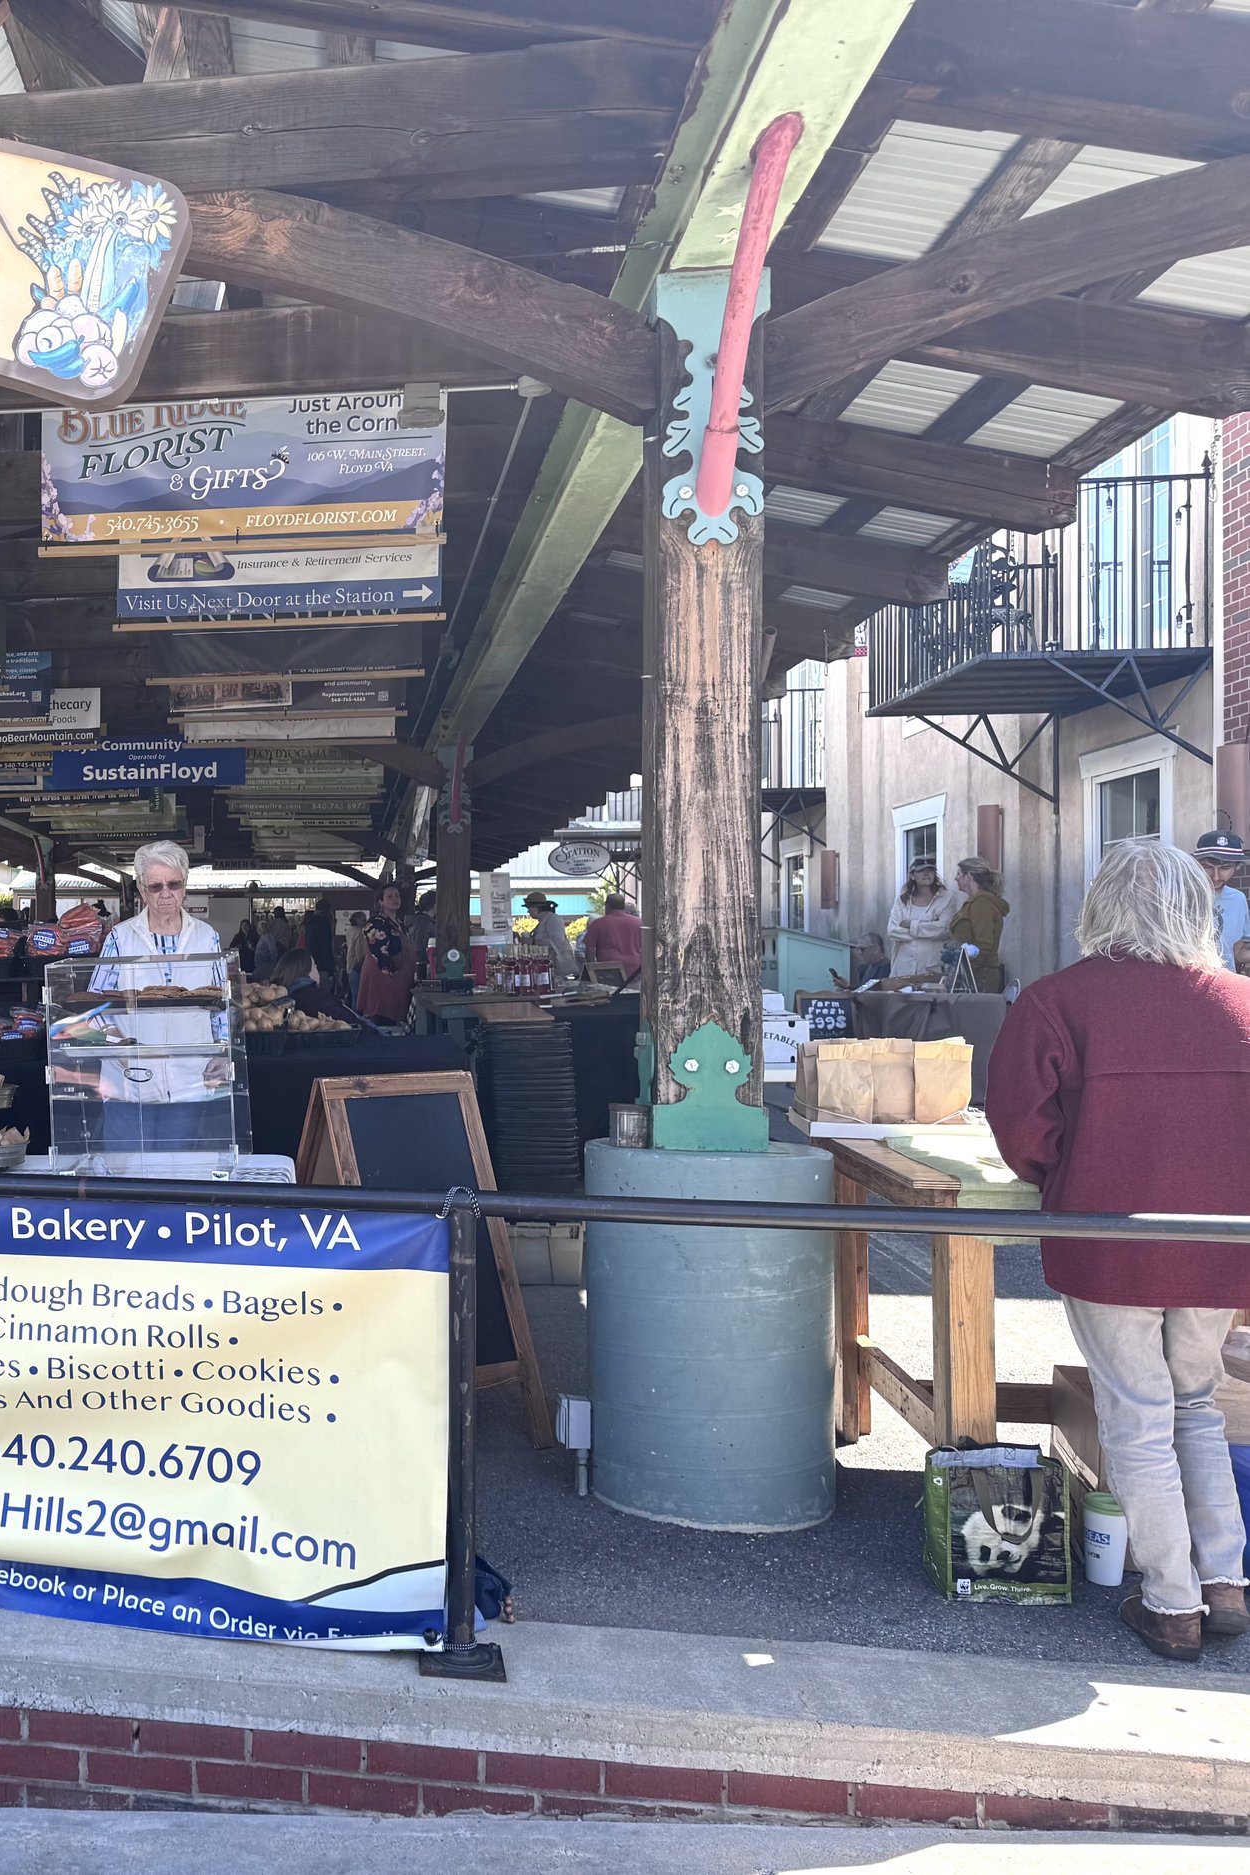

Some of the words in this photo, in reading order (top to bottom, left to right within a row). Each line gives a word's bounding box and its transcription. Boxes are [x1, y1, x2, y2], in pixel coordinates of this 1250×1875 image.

[289, 396, 331, 415] Just
[336, 394, 403, 411] Aroun
[57, 407, 145, 446] BLUE
[306, 418, 341, 435] the
[346, 415, 398, 433] Corn
[78, 427, 234, 480] FLORIST
[307, 451, 325, 462] 106
[169, 474, 184, 491] &
[189, 460, 287, 500] GIFTS
[106, 514, 199, 537] 540.745.3655
[245, 509, 397, 528] FLOYDFLORIST.COM
[237, 557, 287, 570] Insurance
[291, 557, 300, 568] &
[304, 554, 362, 567] Retirement
[365, 552, 412, 563] Services
[125, 593, 162, 611] Visit
[166, 593, 189, 611] Us
[191, 592, 232, 610] Next
[237, 590, 281, 607] Door
[285, 592, 302, 605] at
[304, 589, 332, 604] the
[335, 586, 394, 603] Station
[52, 715, 77, 724] Foods
[101, 739, 182, 753] Community
[82, 762, 217, 782] SustainFloyd
[556, 846, 600, 862] STATION
[808, 1007, 845, 1015] Fresh
[811, 1000, 840, 1008] Farm
[763, 1032, 798, 1050] ETABLES
[12, 1209, 146, 1248] Bakery
[185, 1213, 288, 1252] Pilot,
[300, 1213, 361, 1251] VA
[92, 1283, 195, 1313] Breads
[222, 1290, 324, 1321] Bagels
[146, 1323, 221, 1349] Rolls
[46, 1357, 166, 1382] Biscotti
[192, 1359, 321, 1386] Cookies
[15, 1389, 73, 1411] And
[81, 1390, 172, 1412] Other
[180, 1393, 312, 1424] Goodies
[1086, 1529, 1111, 1544] DEAS
[990, 1583, 1009, 1591] Grow.
[73, 1583, 97, 1601] or
[103, 1583, 165, 1617] Place
[172, 1601, 202, 1622] an
[209, 1607, 277, 1639] Order
